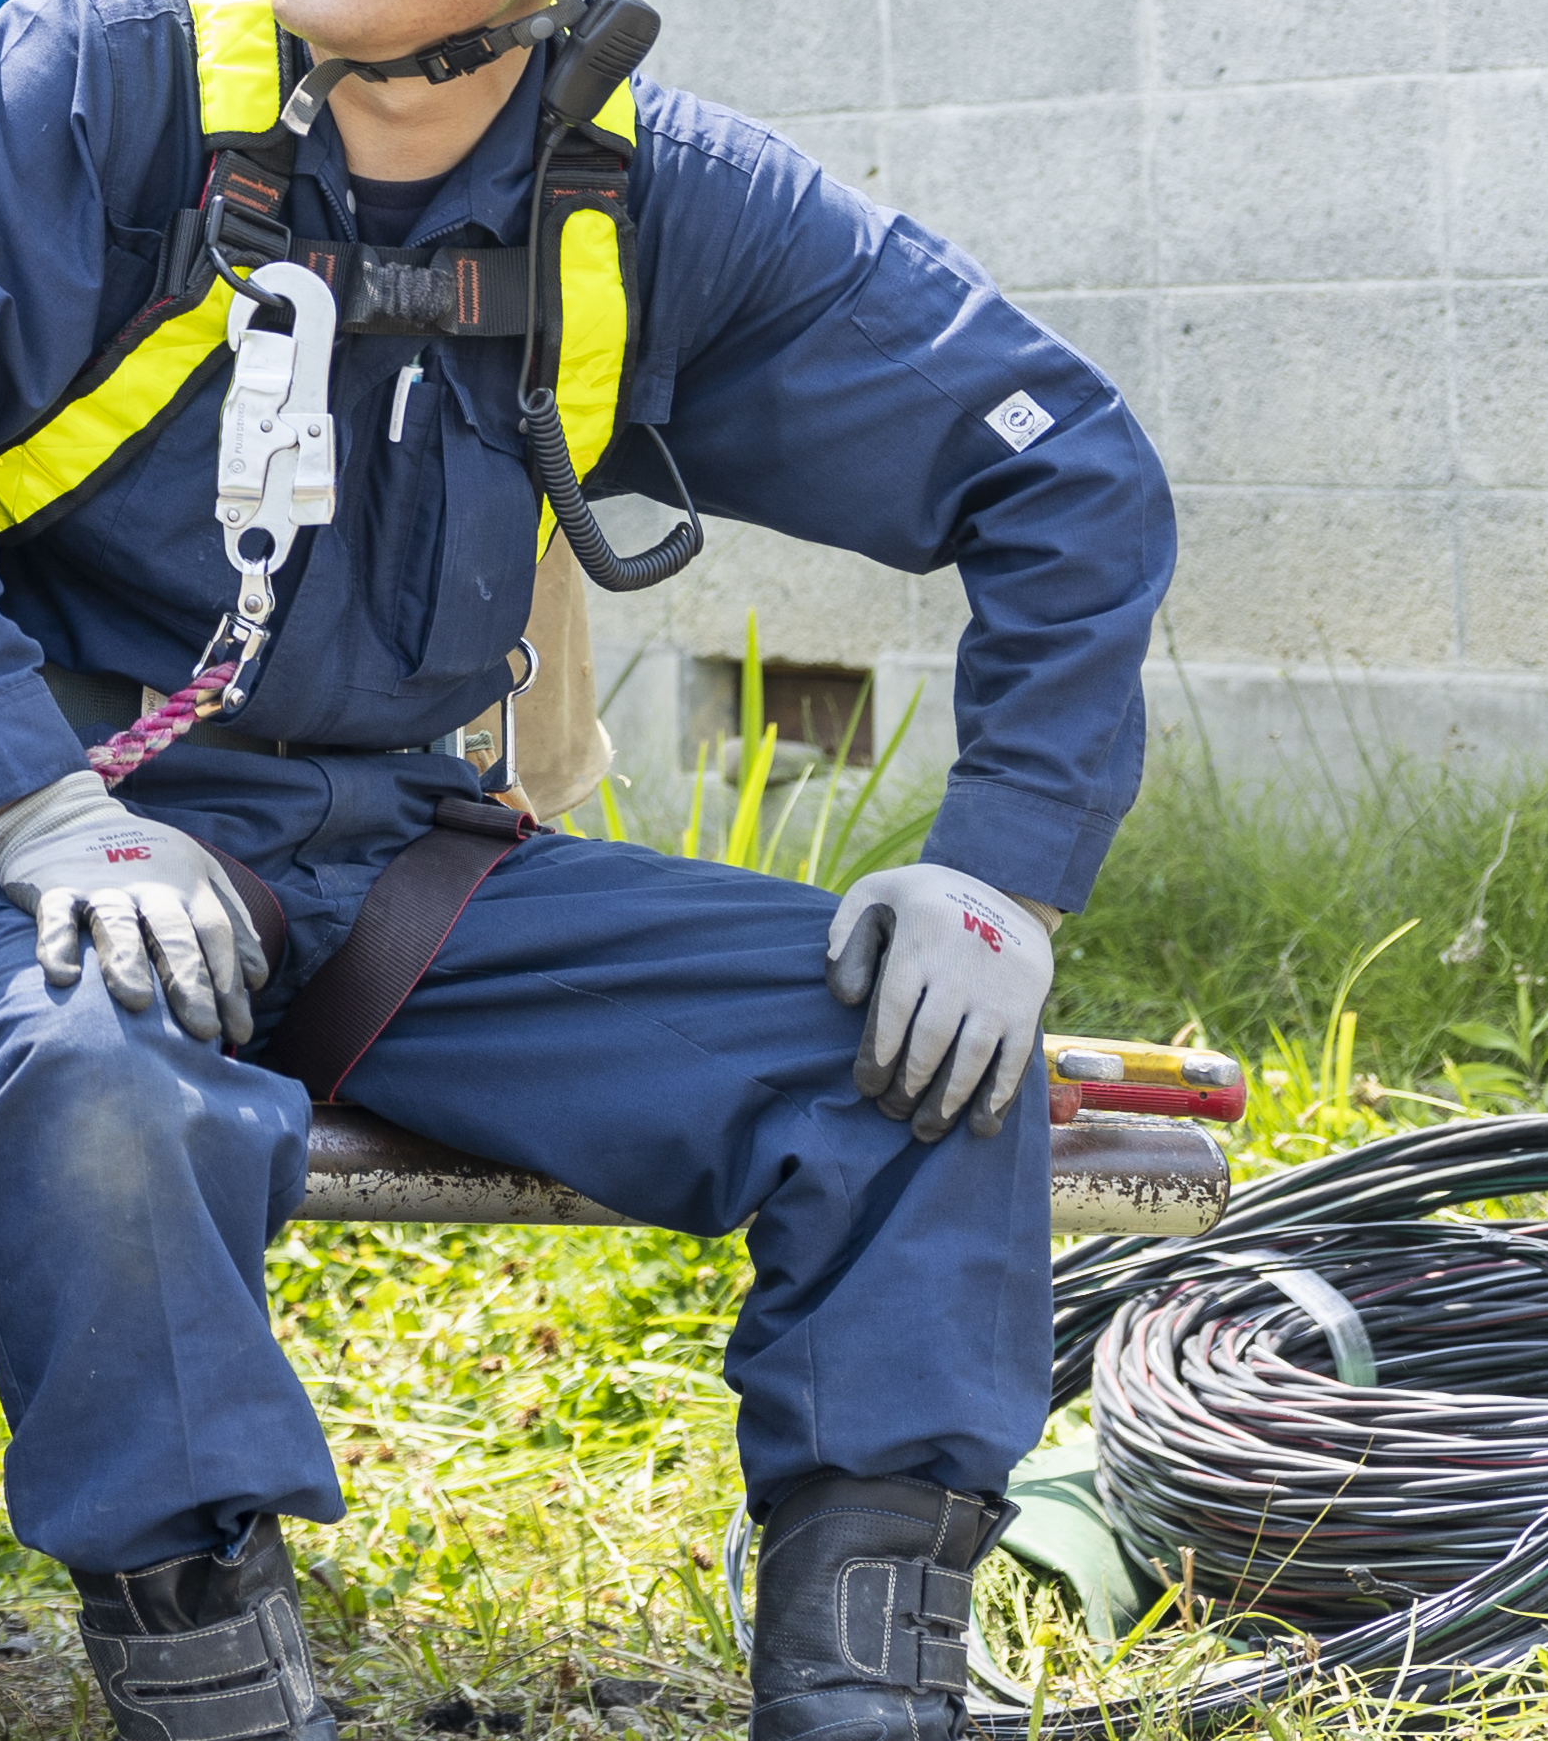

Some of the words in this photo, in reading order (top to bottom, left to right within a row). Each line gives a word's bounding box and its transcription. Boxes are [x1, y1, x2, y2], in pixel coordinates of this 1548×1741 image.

[98, 830, 144, 842] Gloves
[105, 846, 152, 864] 3M
[962, 892, 1005, 925] Gloves
[962, 909, 1003, 954] 3M
